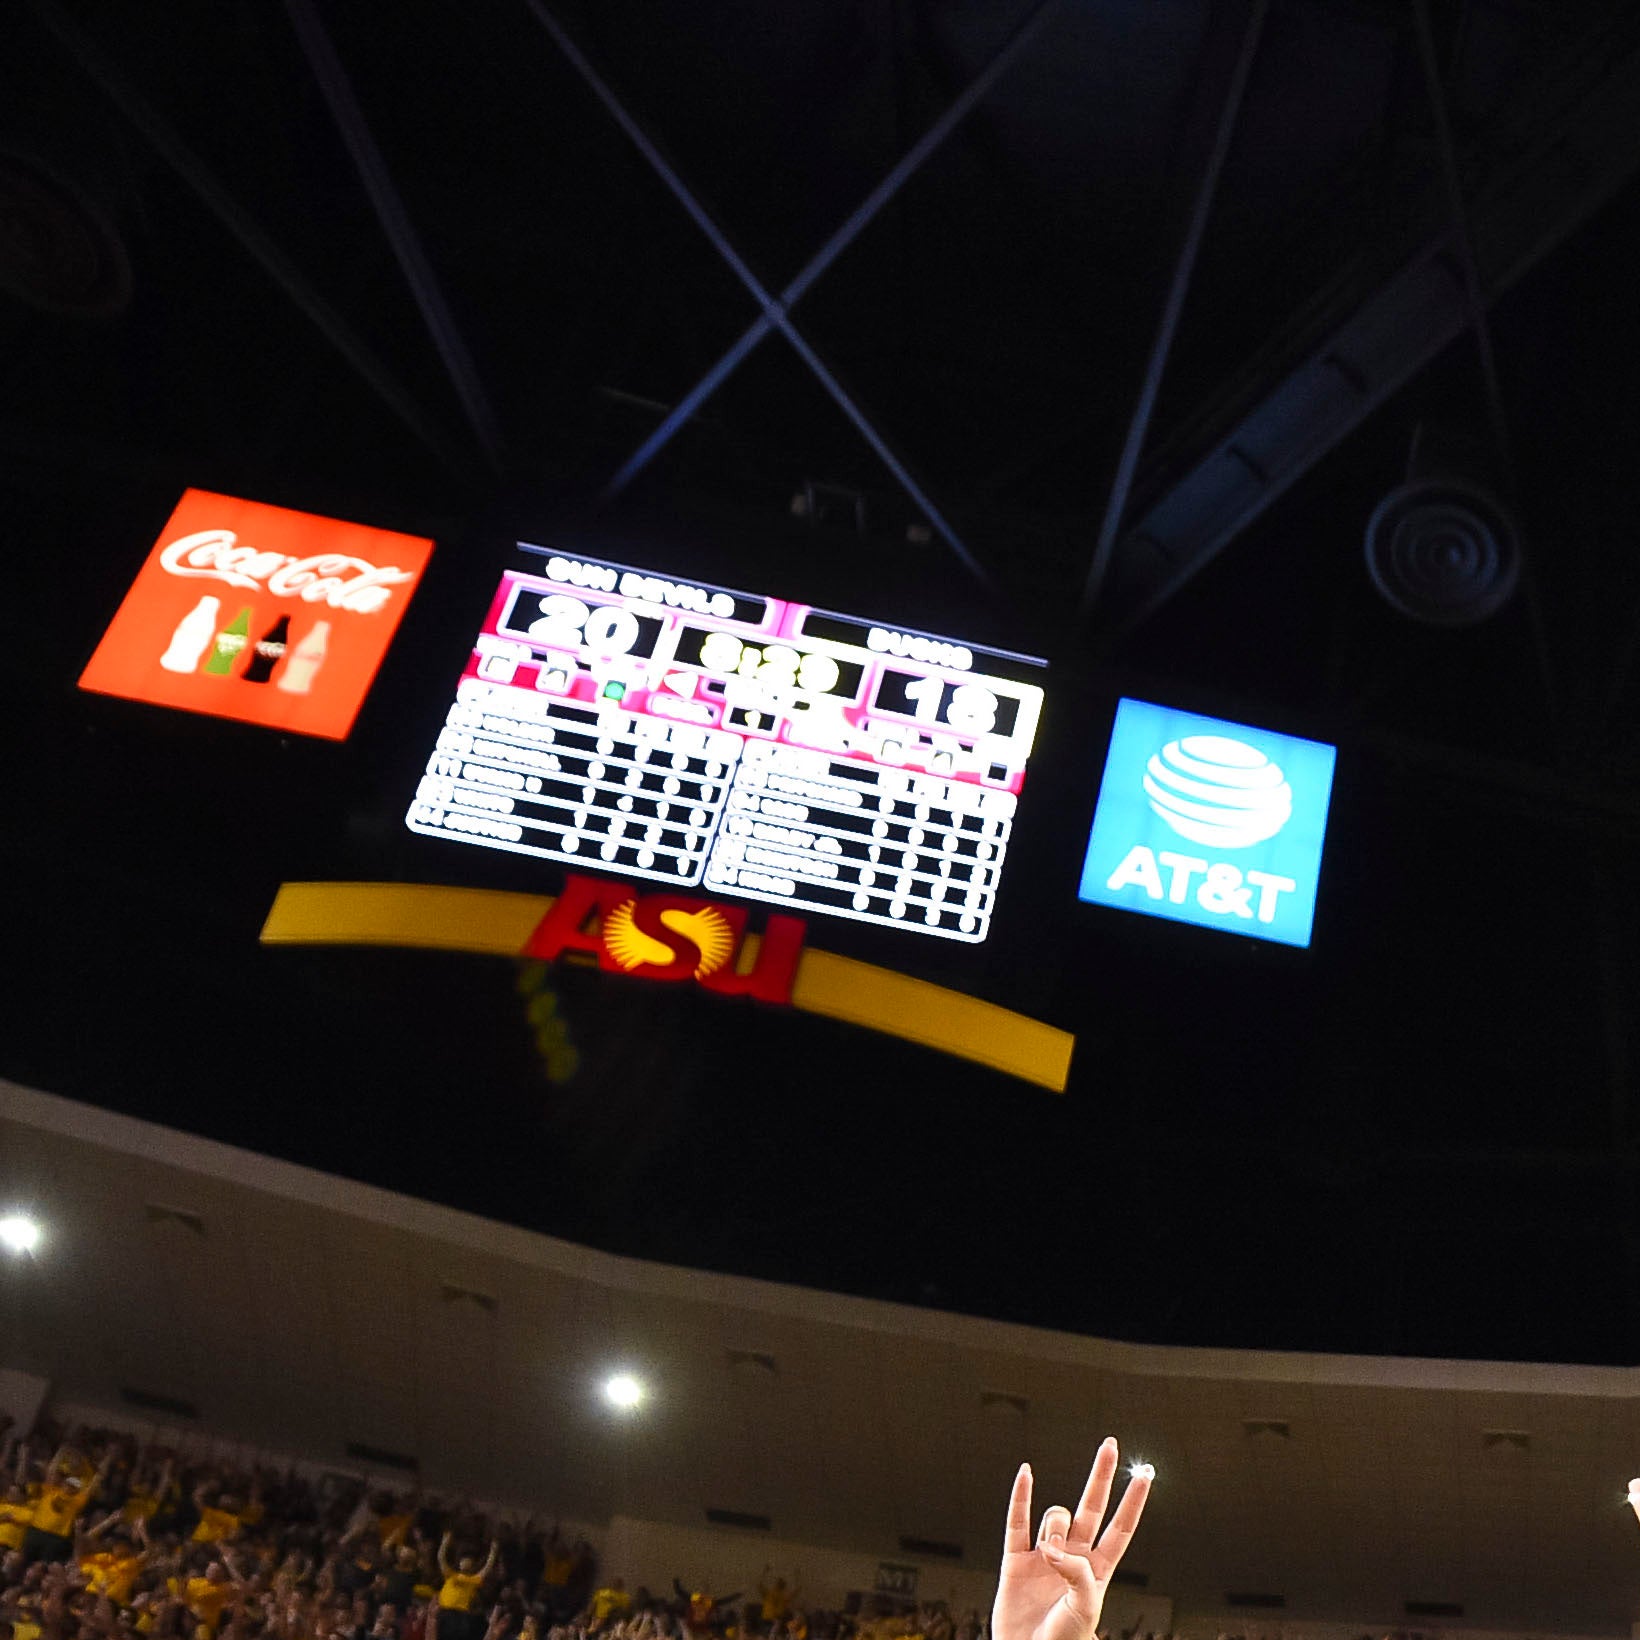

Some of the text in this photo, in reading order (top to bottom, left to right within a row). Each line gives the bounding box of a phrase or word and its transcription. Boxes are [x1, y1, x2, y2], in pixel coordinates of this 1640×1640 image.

[160, 529, 413, 614] Coca-Cola
[528, 594, 640, 656] 20
[1106, 845, 1296, 924] AT&T
[520, 873, 807, 1004] ASU
